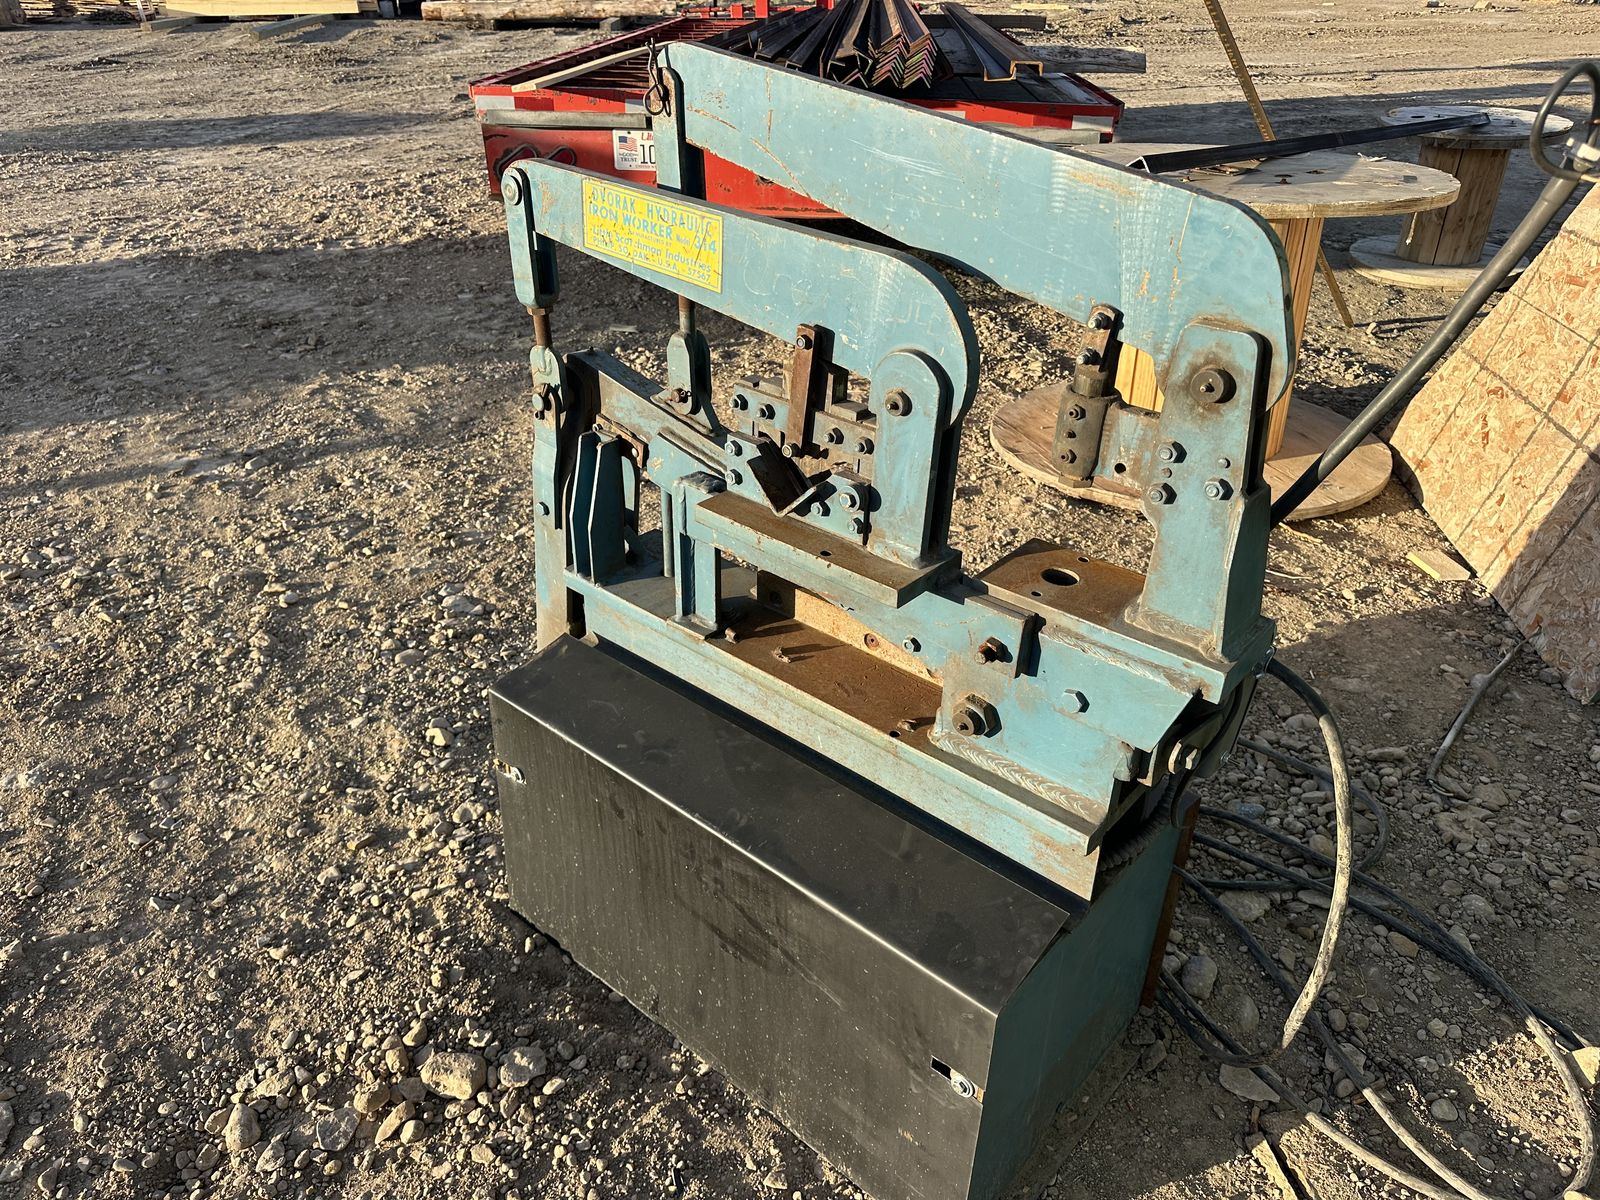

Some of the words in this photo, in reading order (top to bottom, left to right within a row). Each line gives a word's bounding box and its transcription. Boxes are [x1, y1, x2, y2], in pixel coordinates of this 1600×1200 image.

[589, 203, 618, 223] IRON
[623, 213, 673, 240] WORKER
[694, 235, 717, 255] 314
[592, 186, 636, 214] DVORAK
[647, 203, 713, 238] HYDRAULIC
